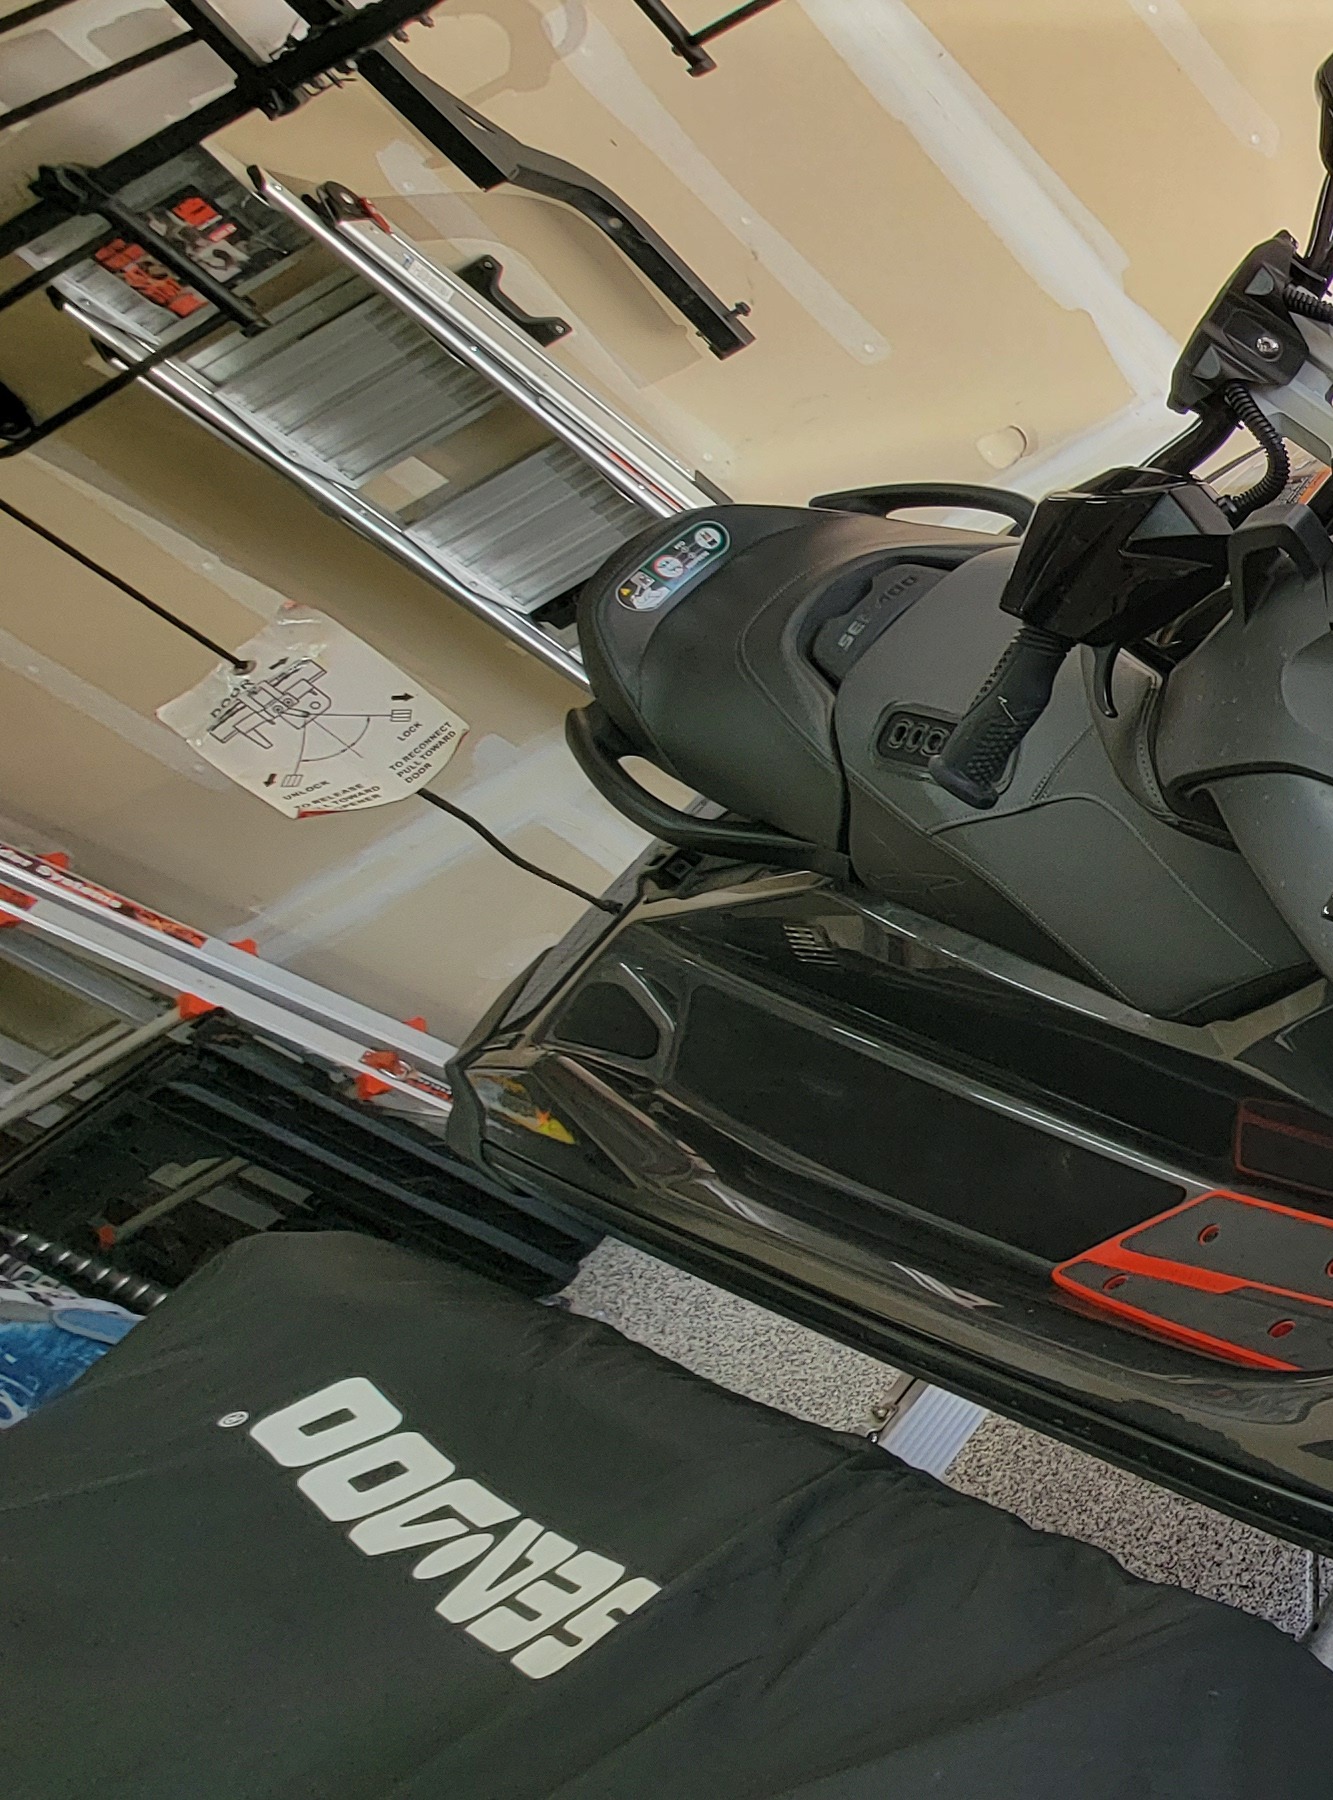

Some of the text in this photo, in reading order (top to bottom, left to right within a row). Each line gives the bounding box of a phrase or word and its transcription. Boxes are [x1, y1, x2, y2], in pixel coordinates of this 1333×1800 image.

[210, 679, 255, 718] DOOR
[397, 722, 422, 741] LOCK
[389, 722, 452, 771] TO RECONNECT
[397, 730, 456, 777] PULL TOWARD
[405, 763, 432, 783] DOOR
[283, 780, 330, 800] UNLOCK
[312, 783, 365, 804] RELEASE
[331, 785, 381, 804] TOWARD
[338, 794, 382, 809] PENER
